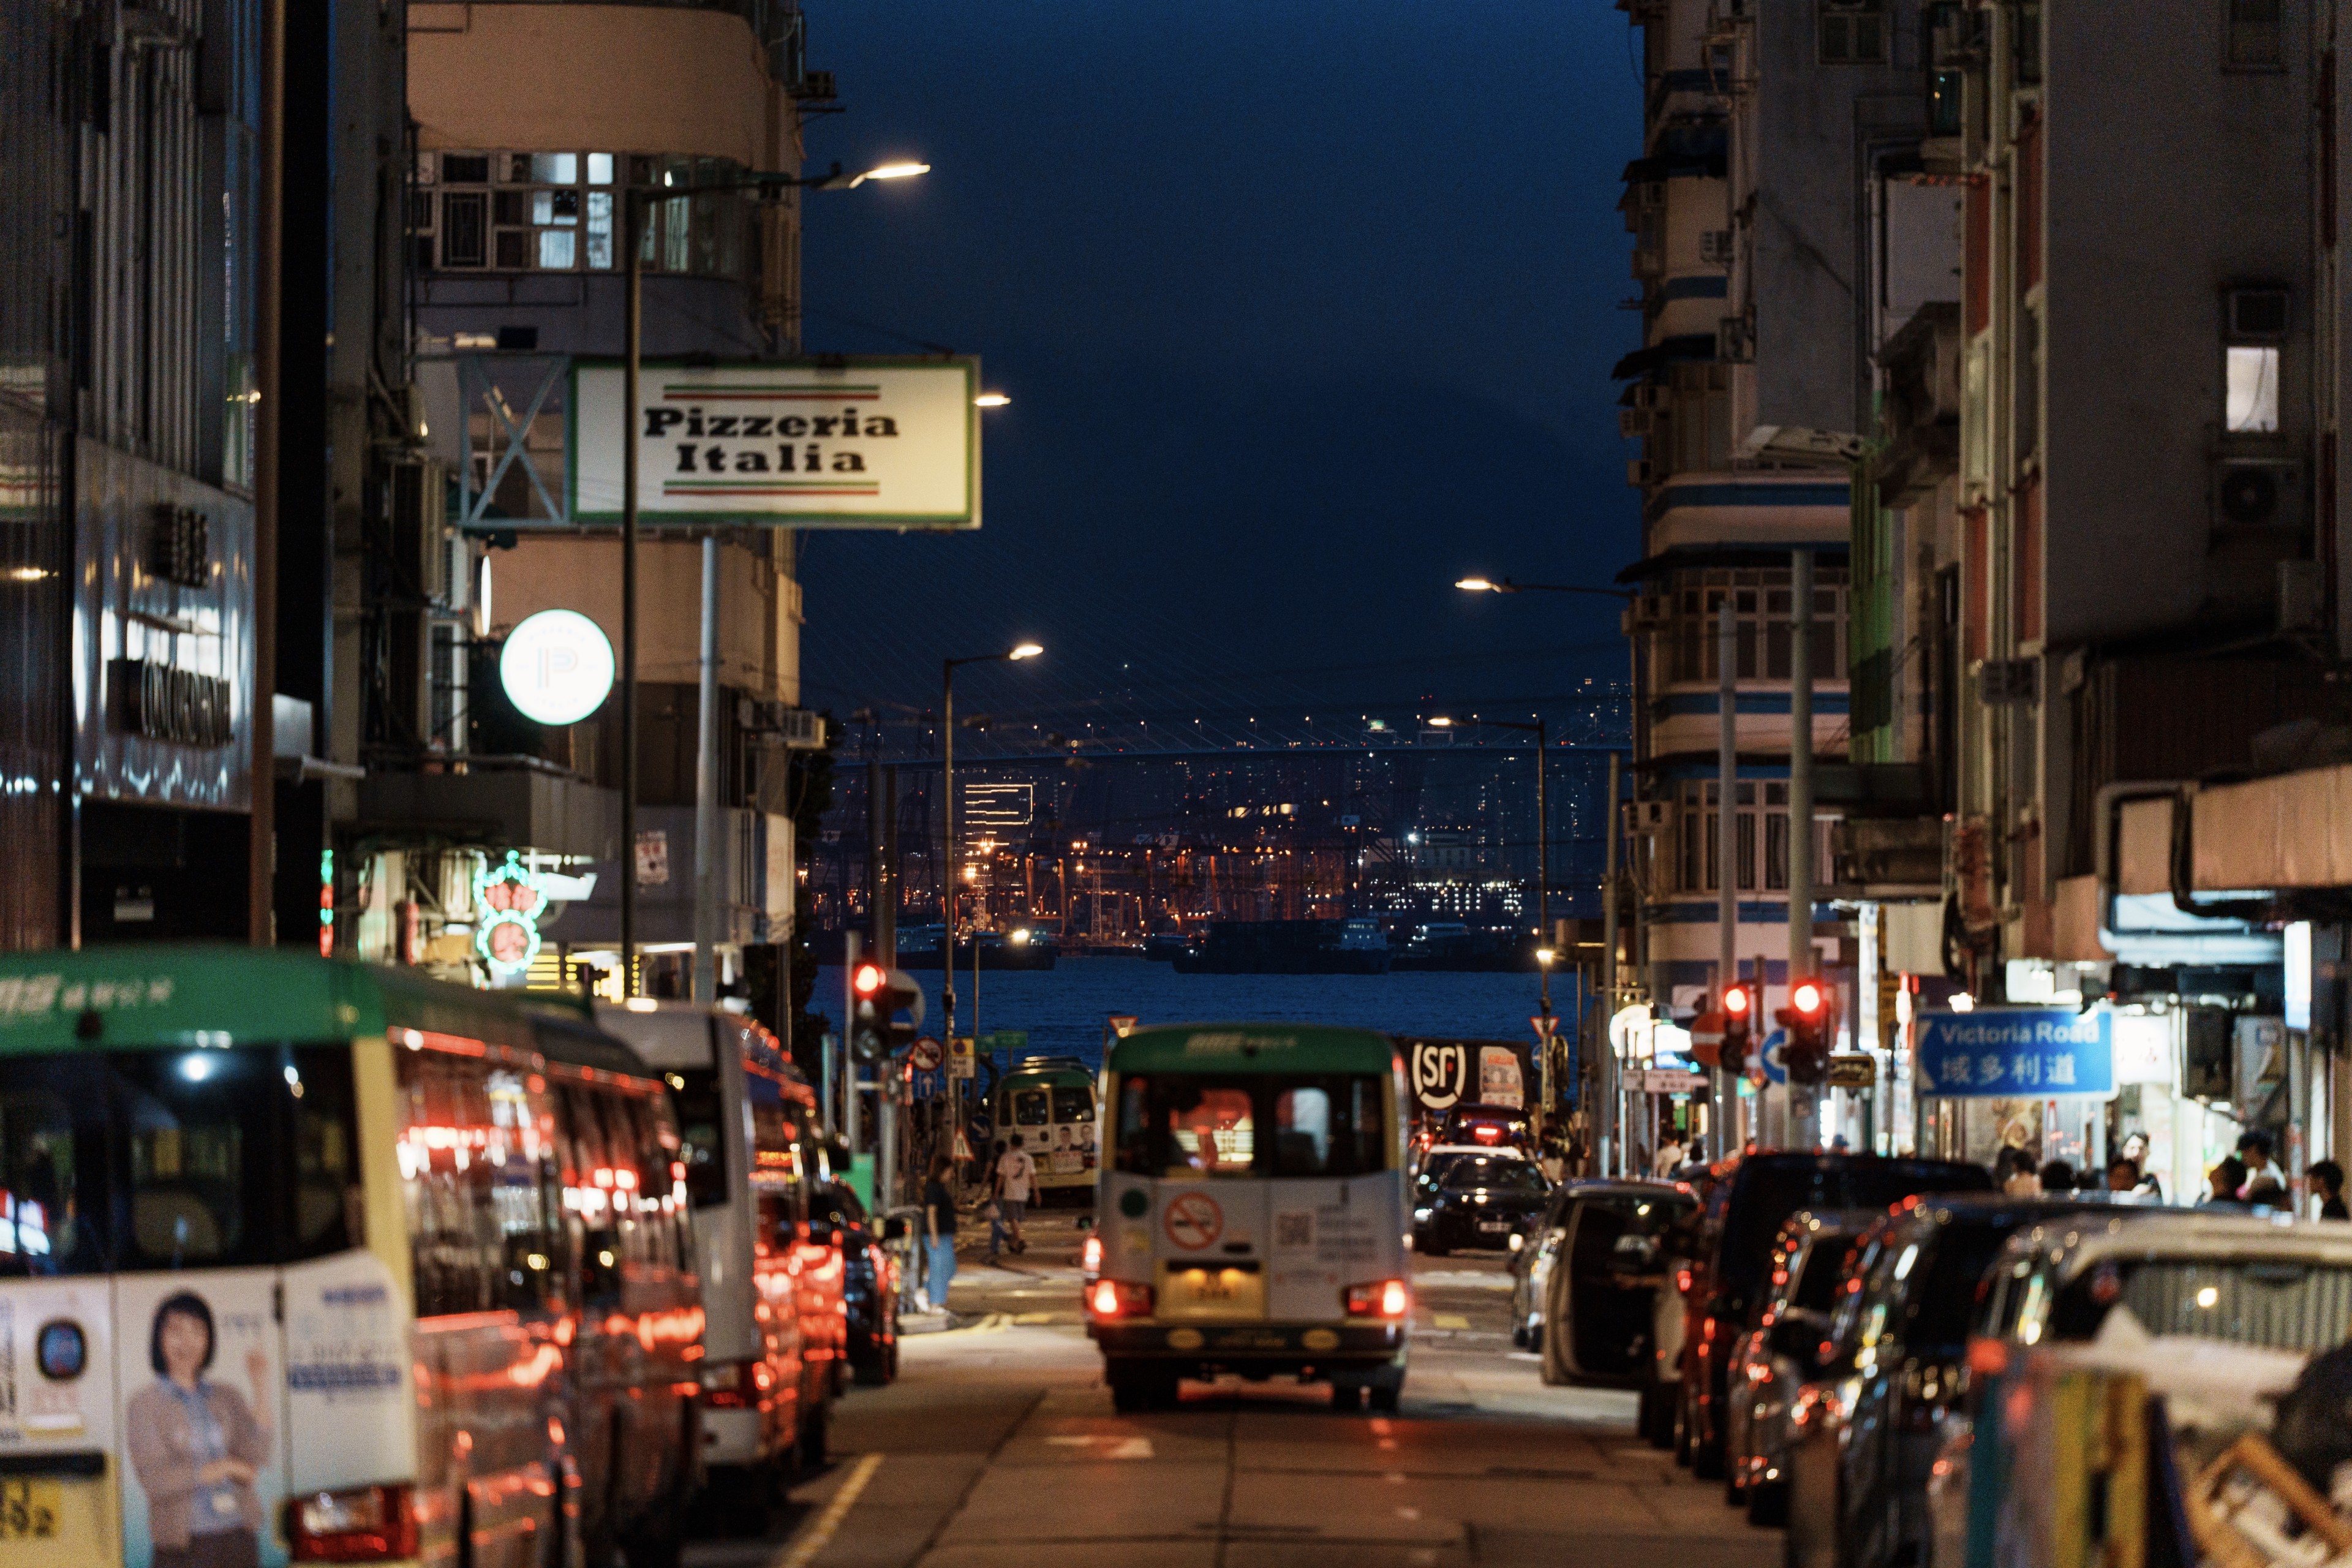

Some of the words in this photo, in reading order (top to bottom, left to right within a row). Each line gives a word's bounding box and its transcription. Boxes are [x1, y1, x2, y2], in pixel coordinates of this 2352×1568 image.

[644, 407, 899, 439] Pizzeria
[676, 444, 867, 473] Italia
[537, 646, 579, 690] P
[1940, 1022, 2030, 1044] Victoria
[2035, 1020, 2100, 1044] Road
[1940, 1051, 2078, 1086] 域多利道
